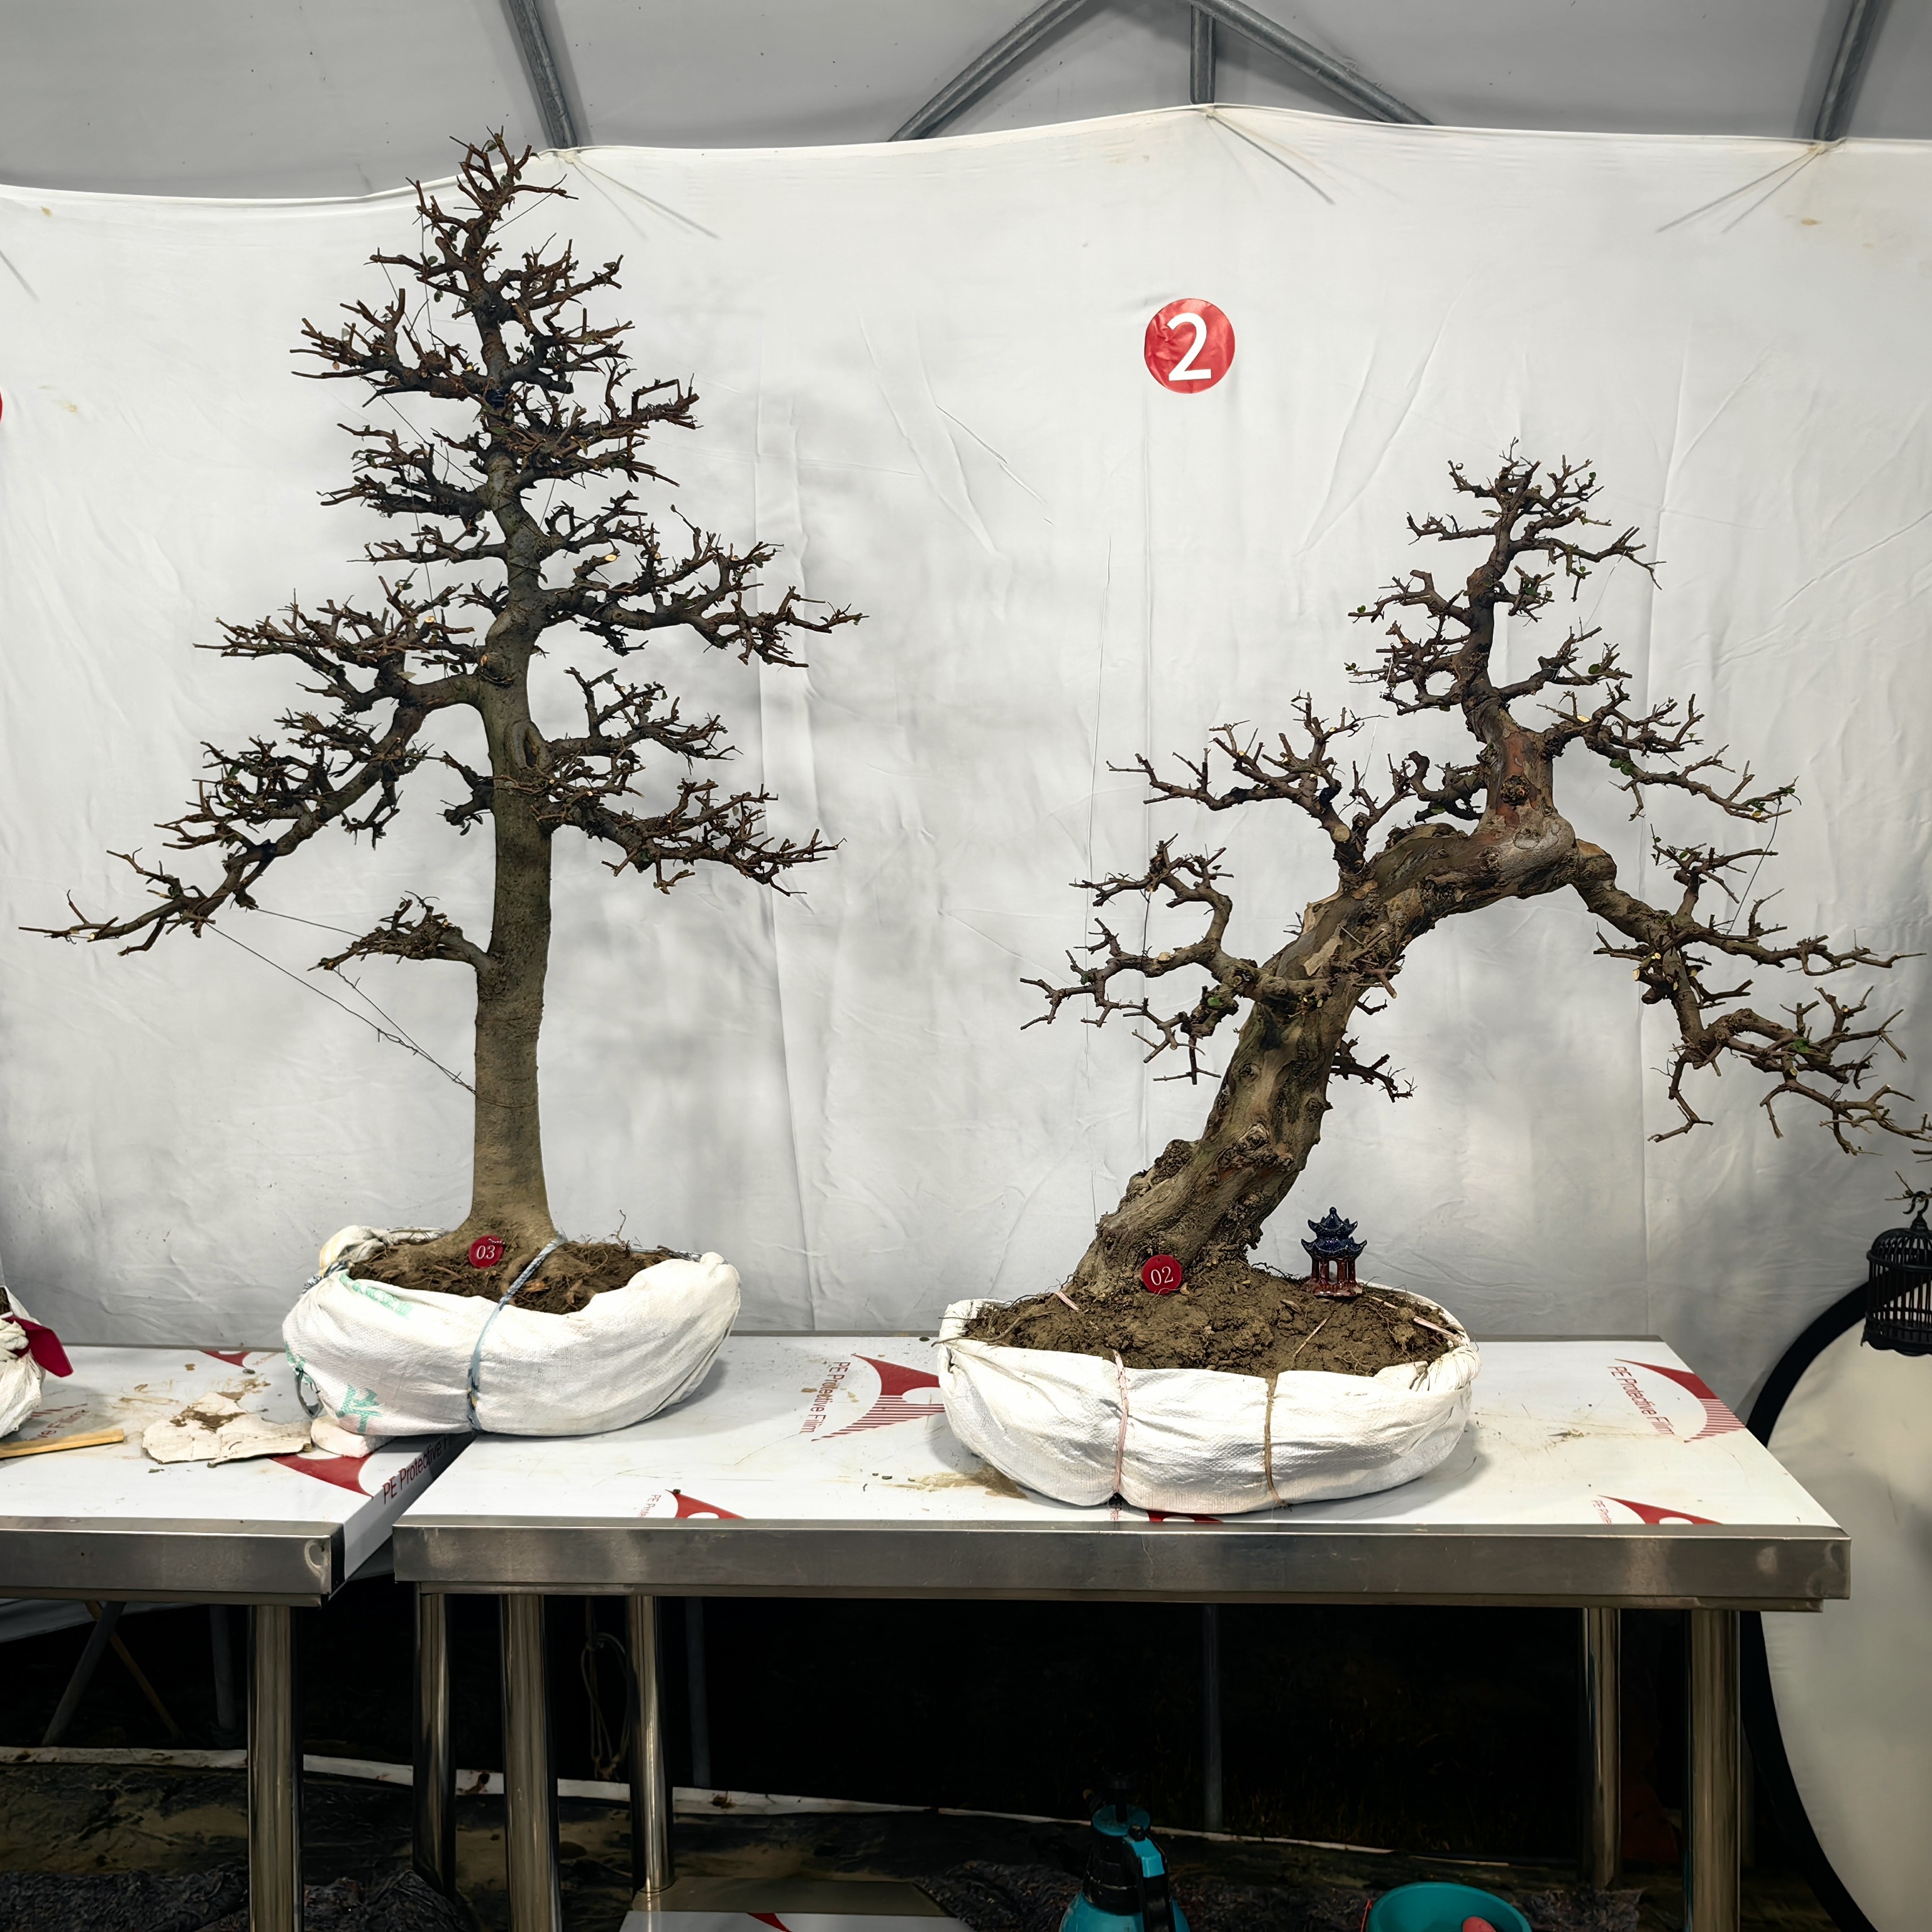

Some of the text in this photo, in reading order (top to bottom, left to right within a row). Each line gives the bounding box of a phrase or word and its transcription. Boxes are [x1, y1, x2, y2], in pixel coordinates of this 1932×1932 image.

[1167, 313, 1211, 381] 2
[477, 1245, 495, 1260] 03
[1151, 1266, 1174, 1285] 02
[828, 1362, 851, 1373] PE
[809, 1374, 845, 1412] Protective
[1616, 1378, 1657, 1415] Protective
[382, 1476, 397, 1505] PE
[398, 1441, 443, 1491] Protective
